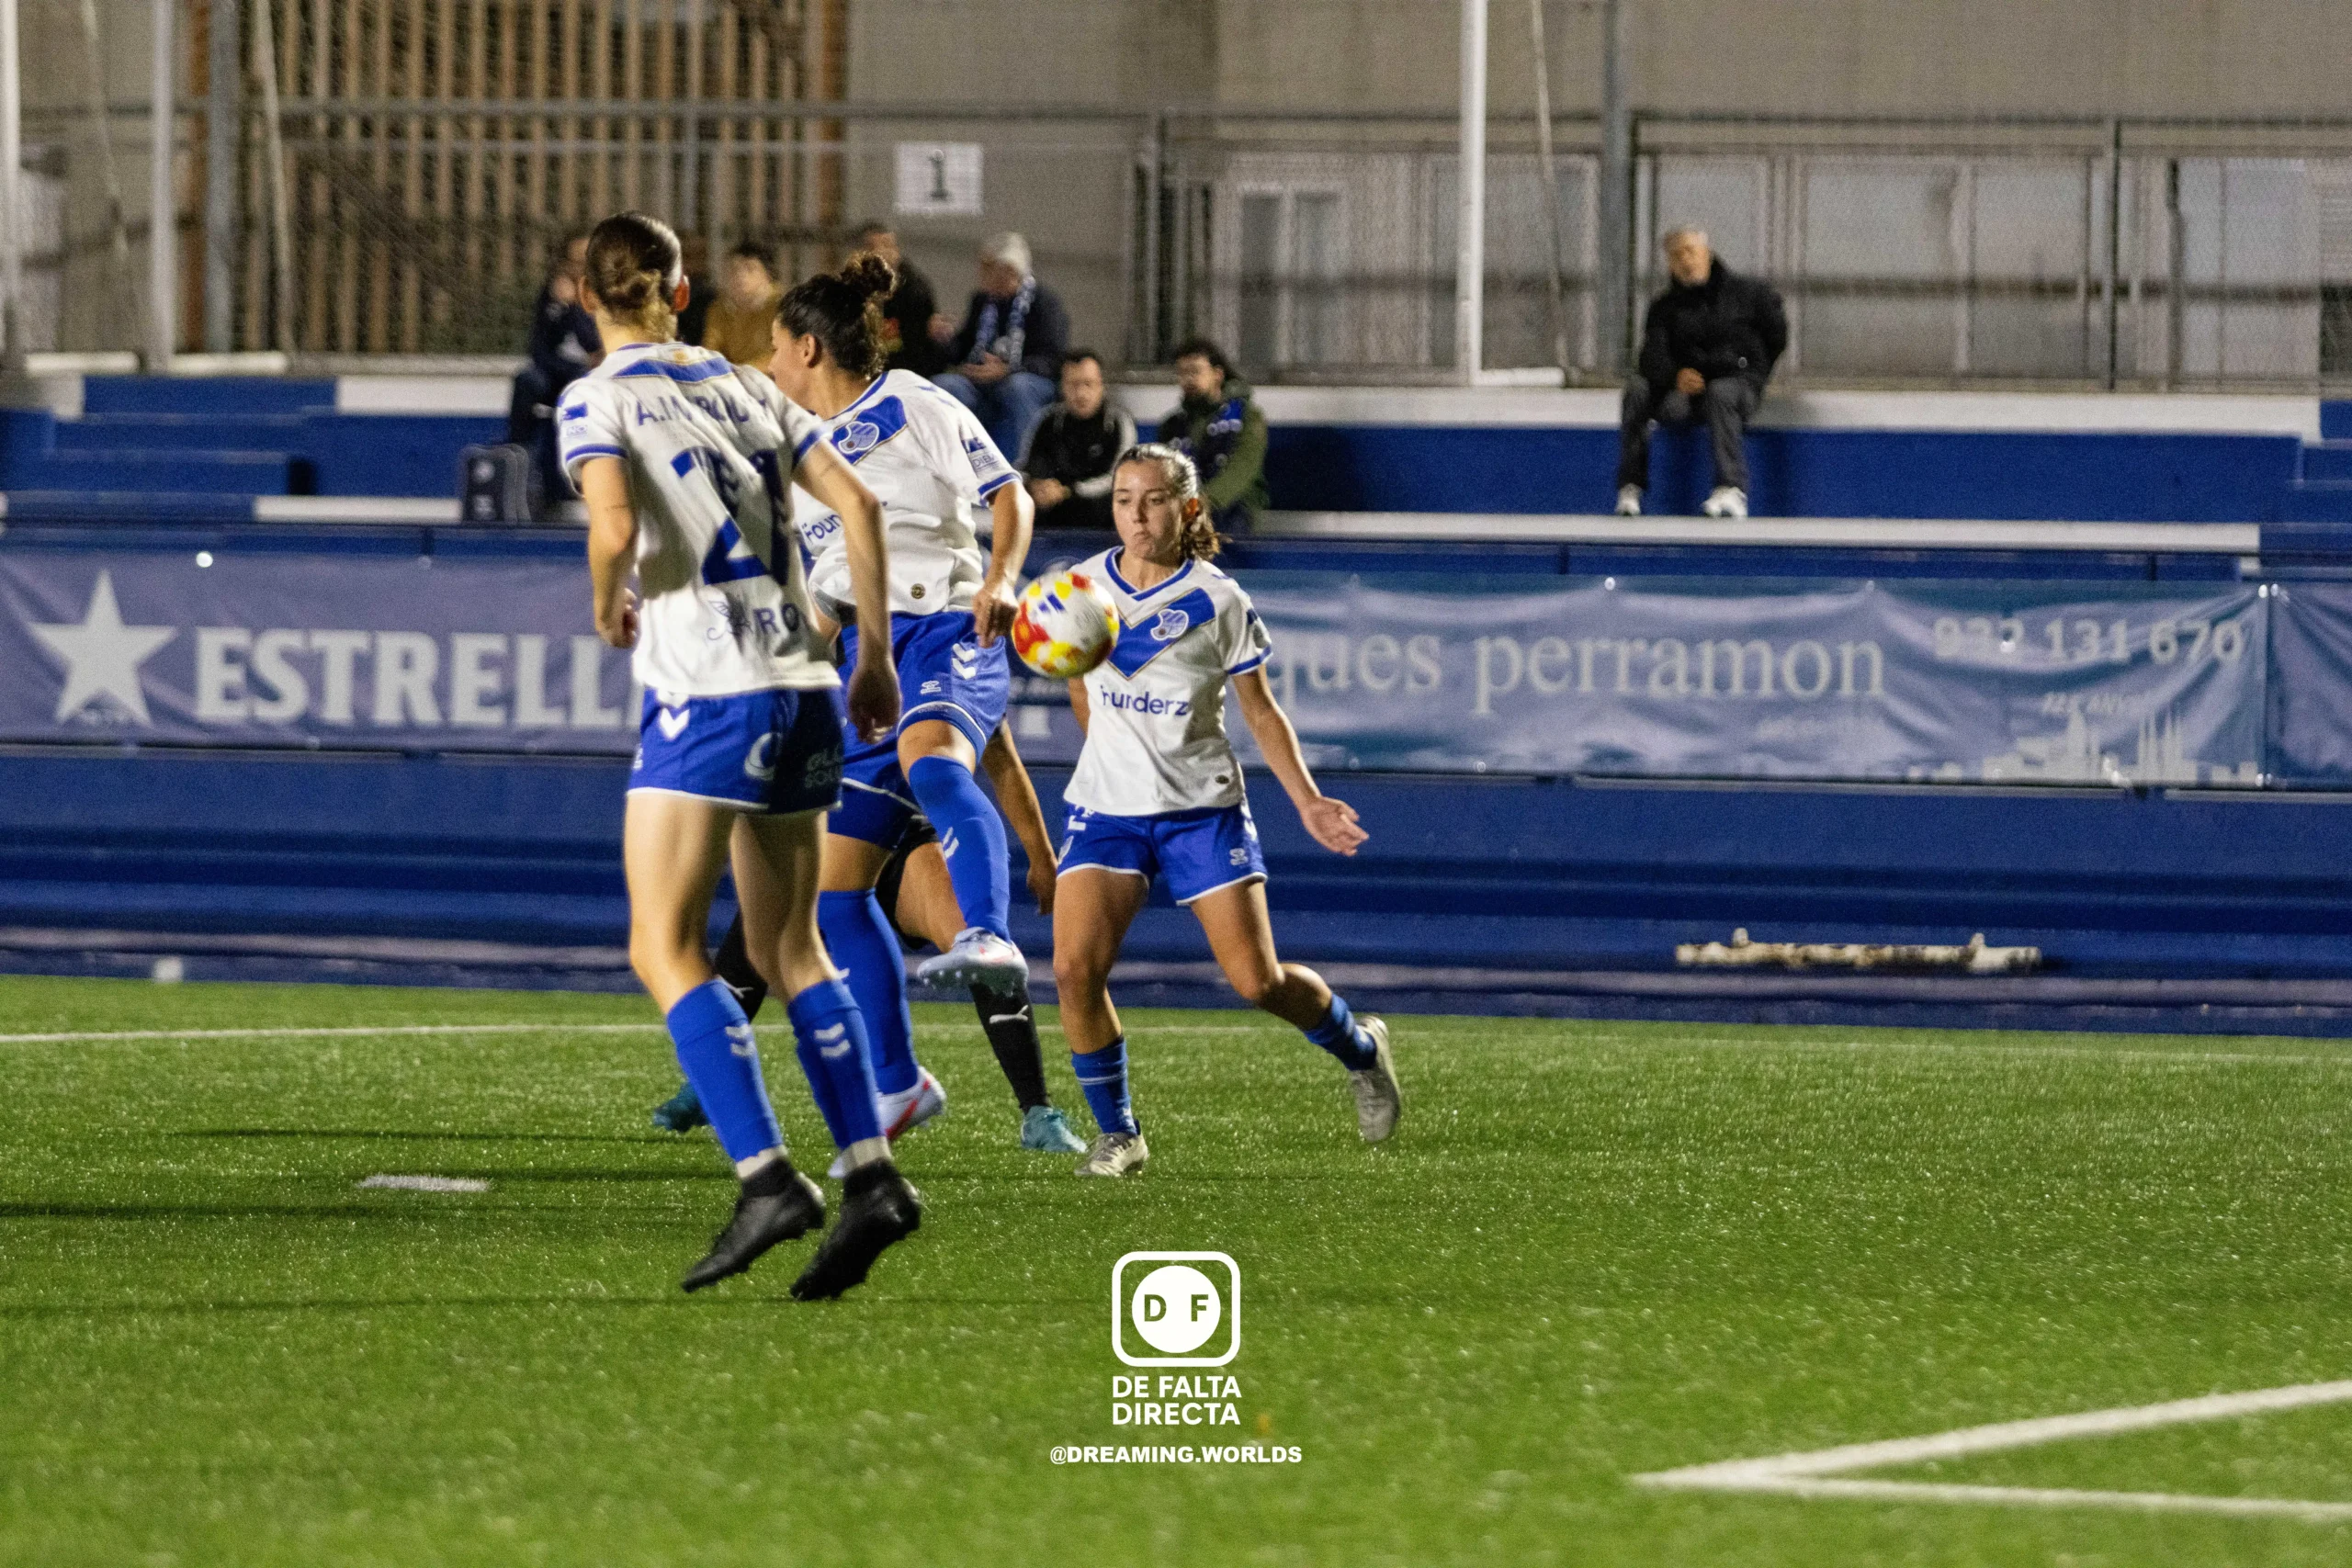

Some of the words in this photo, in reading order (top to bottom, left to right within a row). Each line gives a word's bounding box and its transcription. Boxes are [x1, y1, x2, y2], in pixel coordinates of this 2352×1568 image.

[927, 153, 954, 201] 1
[1265, 633, 1442, 715] ques
[1471, 634, 1885, 716] perramon
[2044, 617, 2132, 664] 131
[2149, 618, 2244, 666] 670
[194, 627, 643, 728] ESTRELL
